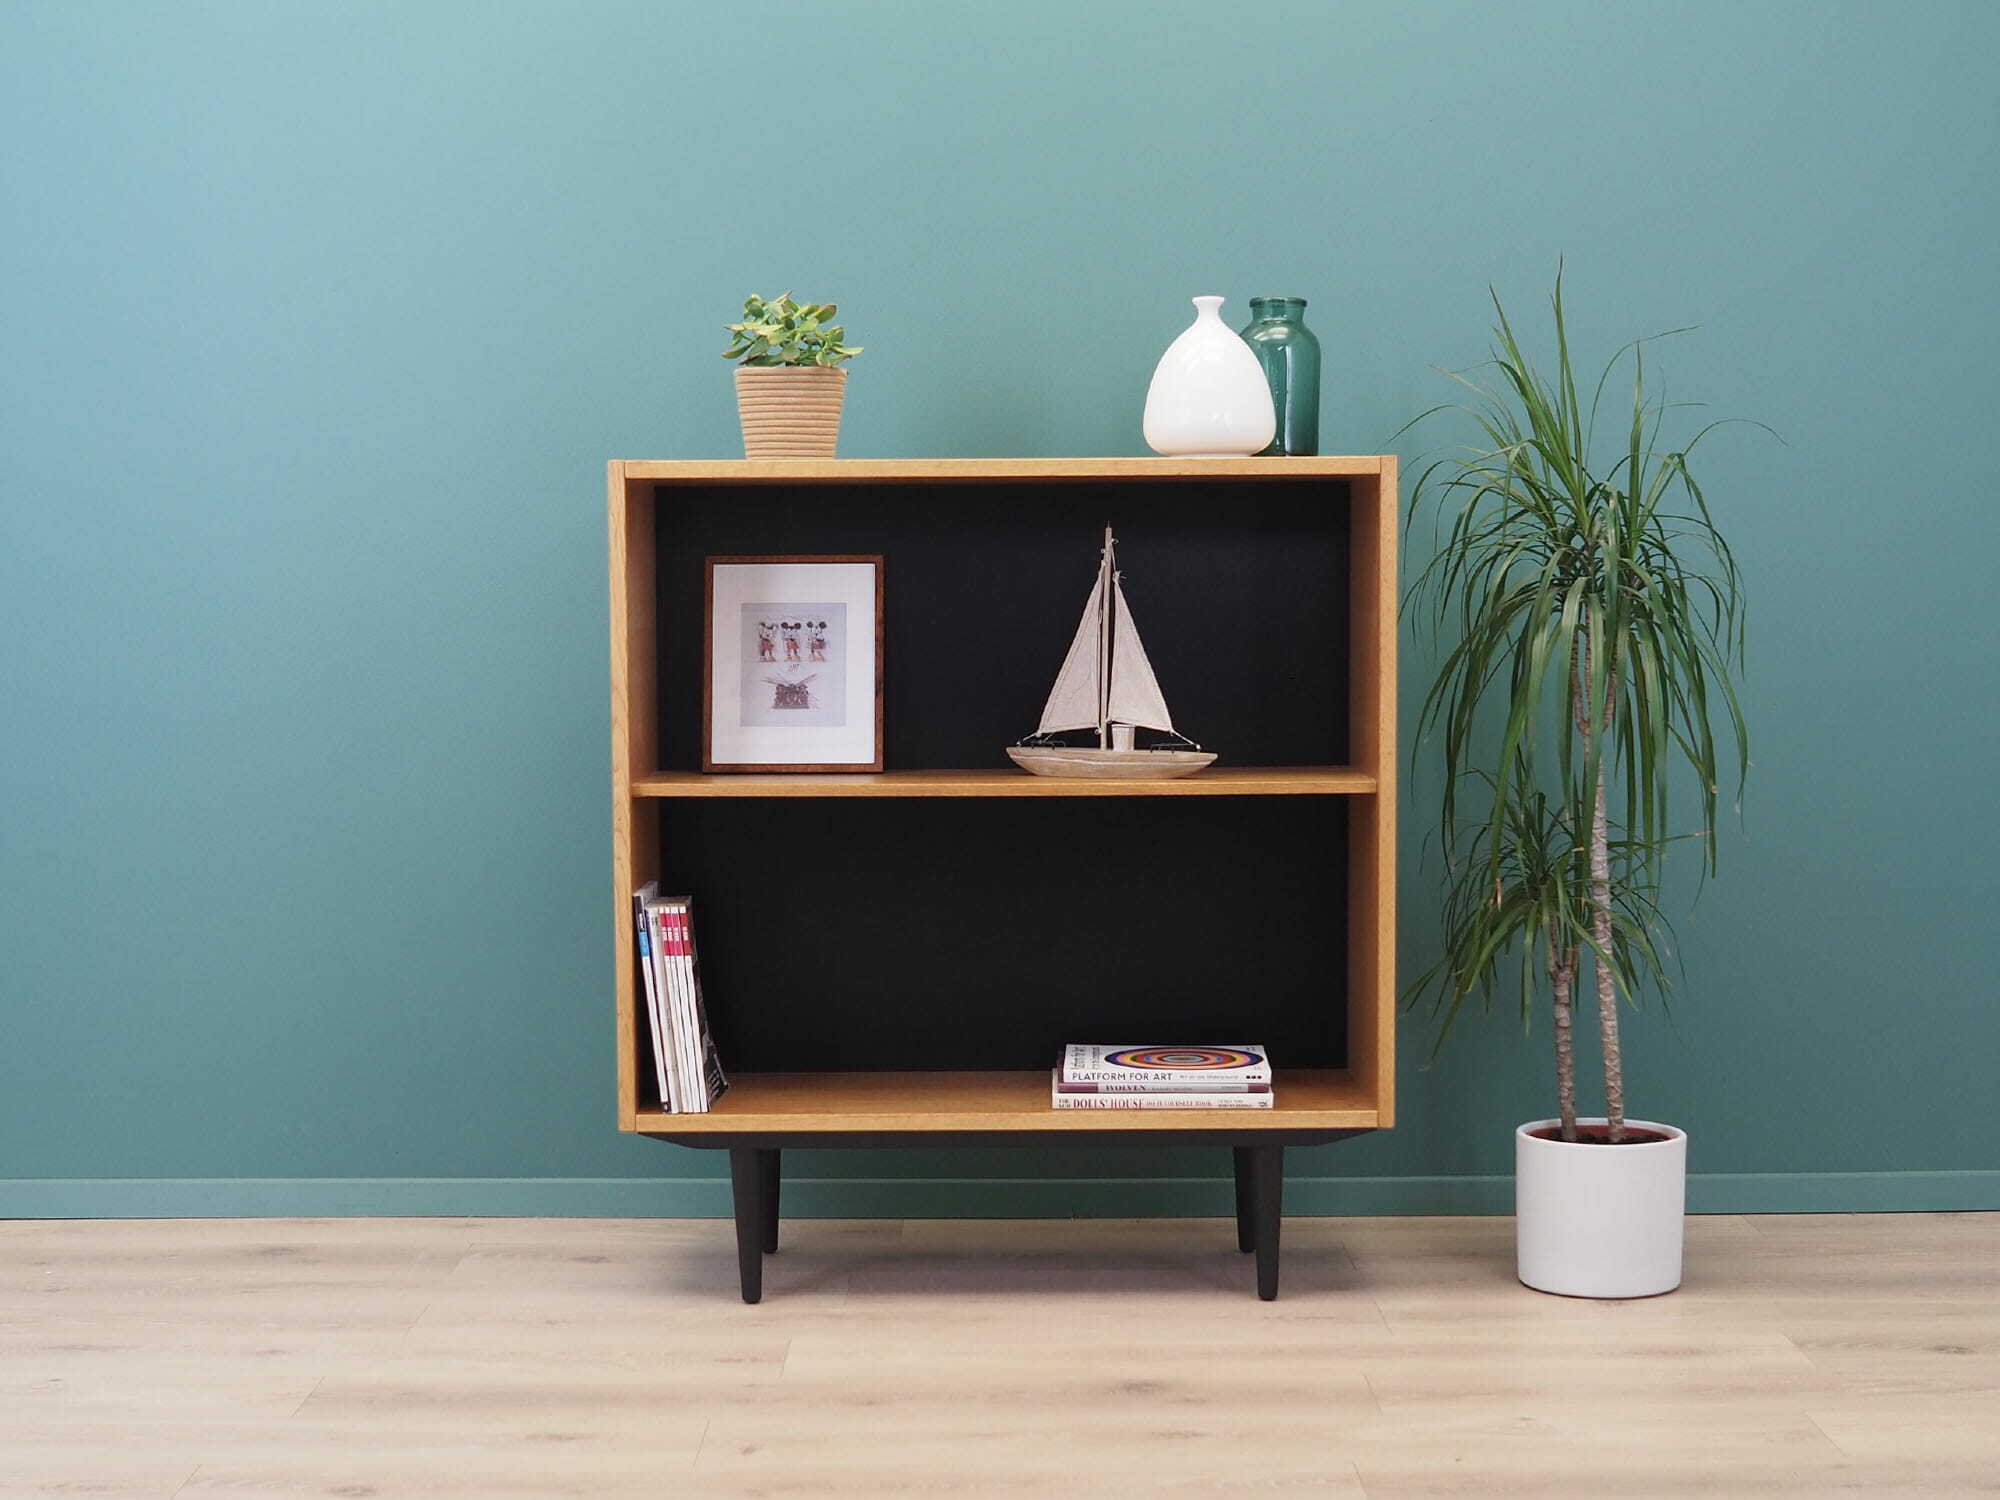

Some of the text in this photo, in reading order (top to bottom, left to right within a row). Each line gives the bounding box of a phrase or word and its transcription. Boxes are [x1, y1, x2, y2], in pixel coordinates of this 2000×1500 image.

[1072, 1072, 1126, 1081] PLATFORM
[1129, 1072, 1150, 1081] FOR
[1153, 1072, 1173, 1081] ART
